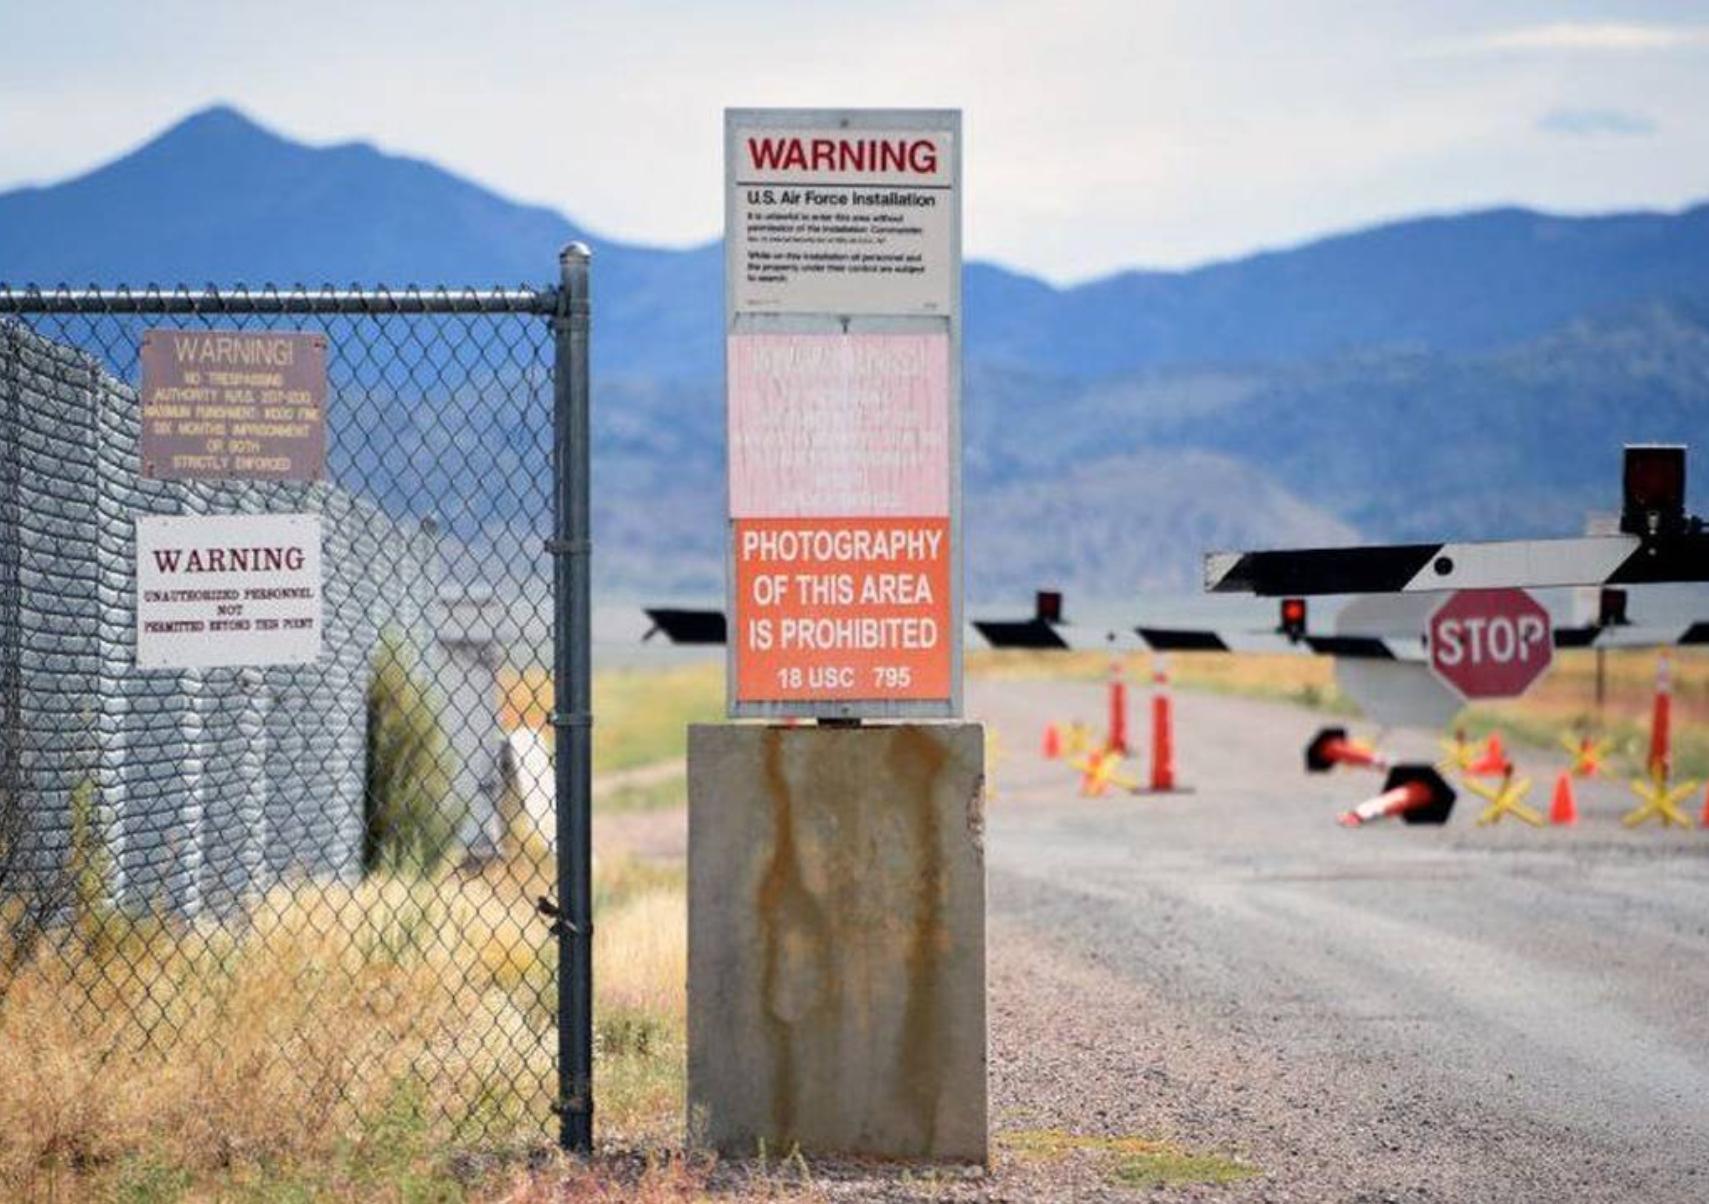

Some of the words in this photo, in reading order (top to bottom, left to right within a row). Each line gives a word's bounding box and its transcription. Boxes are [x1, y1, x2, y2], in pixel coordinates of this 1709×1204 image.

[748, 137, 937, 173] WARNING
[747, 190, 777, 206] U.S.
[780, 191, 801, 206] Air
[805, 192, 848, 206] Force
[853, 193, 935, 207] Installation
[743, 529, 943, 561] PHOTOGRAPHY
[152, 546, 306, 574] WARNING
[143, 588, 240, 603] UNAUTHORIZED
[243, 586, 315, 600] PERSONNEL
[753, 574, 789, 606] OF
[795, 574, 854, 605] THIS
[859, 573, 934, 605] AREA
[216, 604, 244, 616] NOT
[143, 619, 205, 634] PERMITTED
[282, 617, 314, 630] POINT
[749, 617, 774, 651] IS
[779, 617, 938, 650] PROHIBITED
[1437, 615, 1545, 666] STOP
[776, 667, 803, 689] 18
[807, 667, 855, 689] USC
[871, 666, 912, 688] 795
